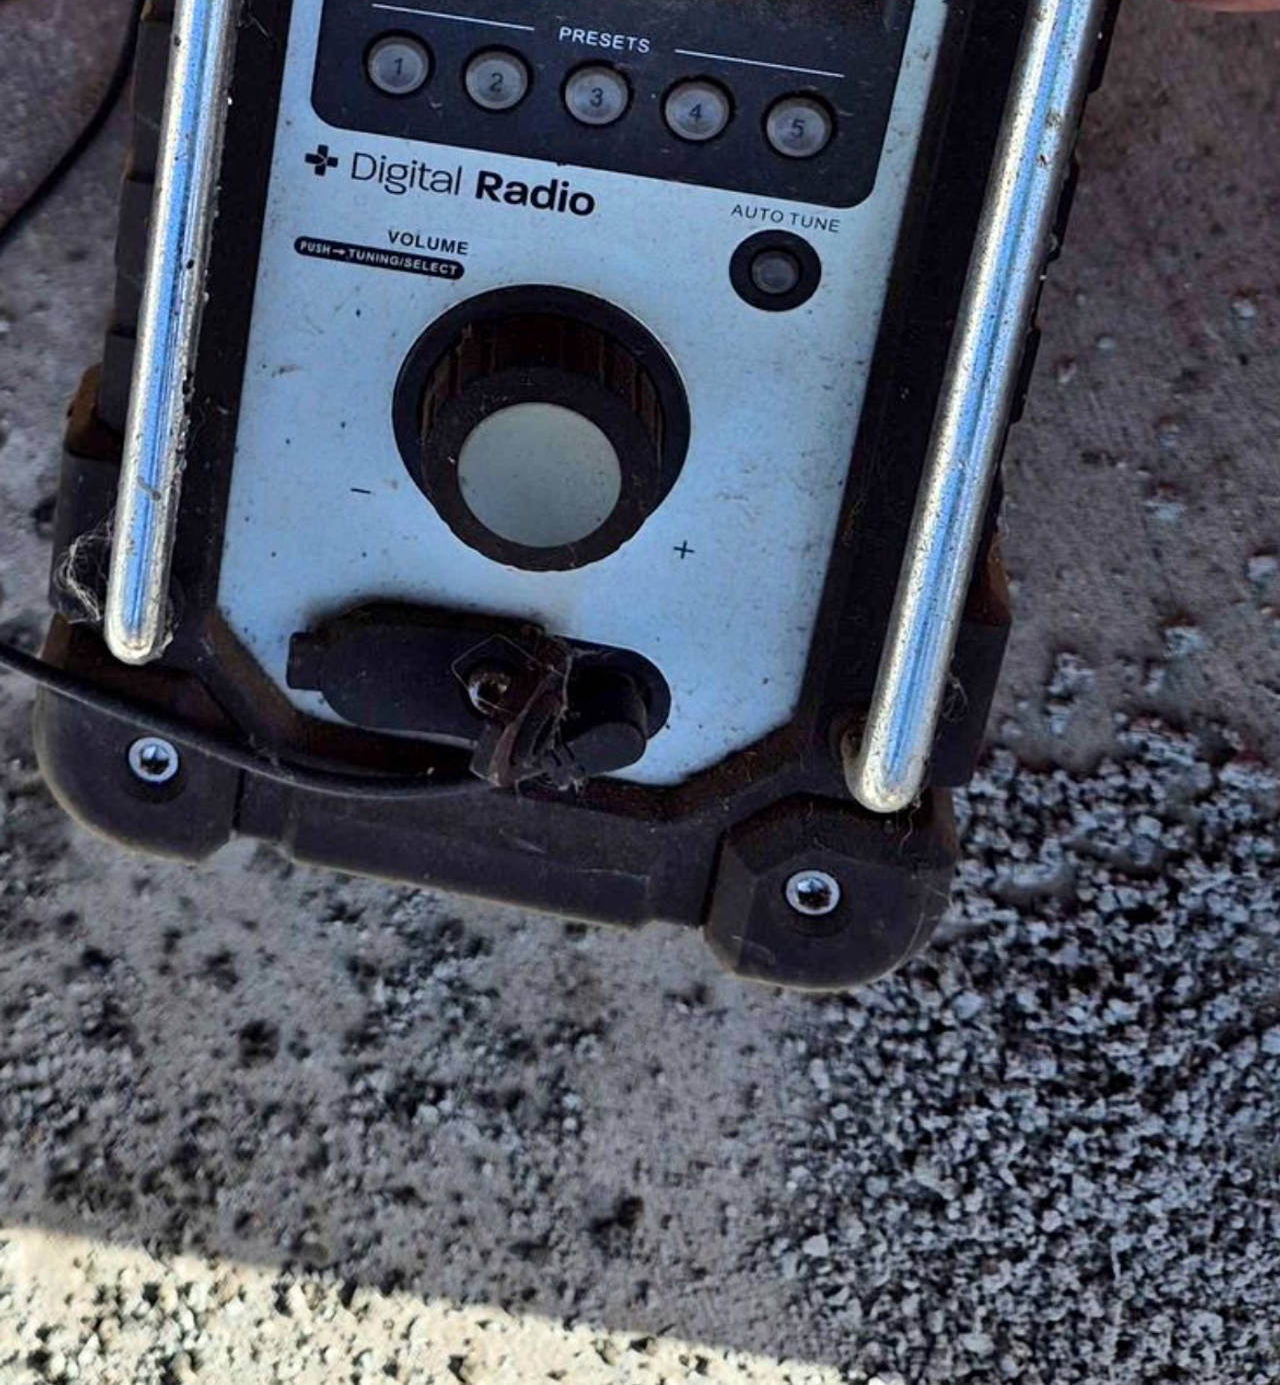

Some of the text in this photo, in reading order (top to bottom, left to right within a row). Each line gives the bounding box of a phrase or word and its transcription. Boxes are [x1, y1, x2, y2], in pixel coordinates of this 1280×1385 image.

[558, 26, 651, 54] PRESETS
[394, 56, 805, 139] 1 2 3 4 5
[350, 152, 596, 216] Digital Radio
[730, 203, 841, 234] AUTO TUNE
[299, 239, 332, 255] PUSH
[387, 229, 469, 257] VOLUME
